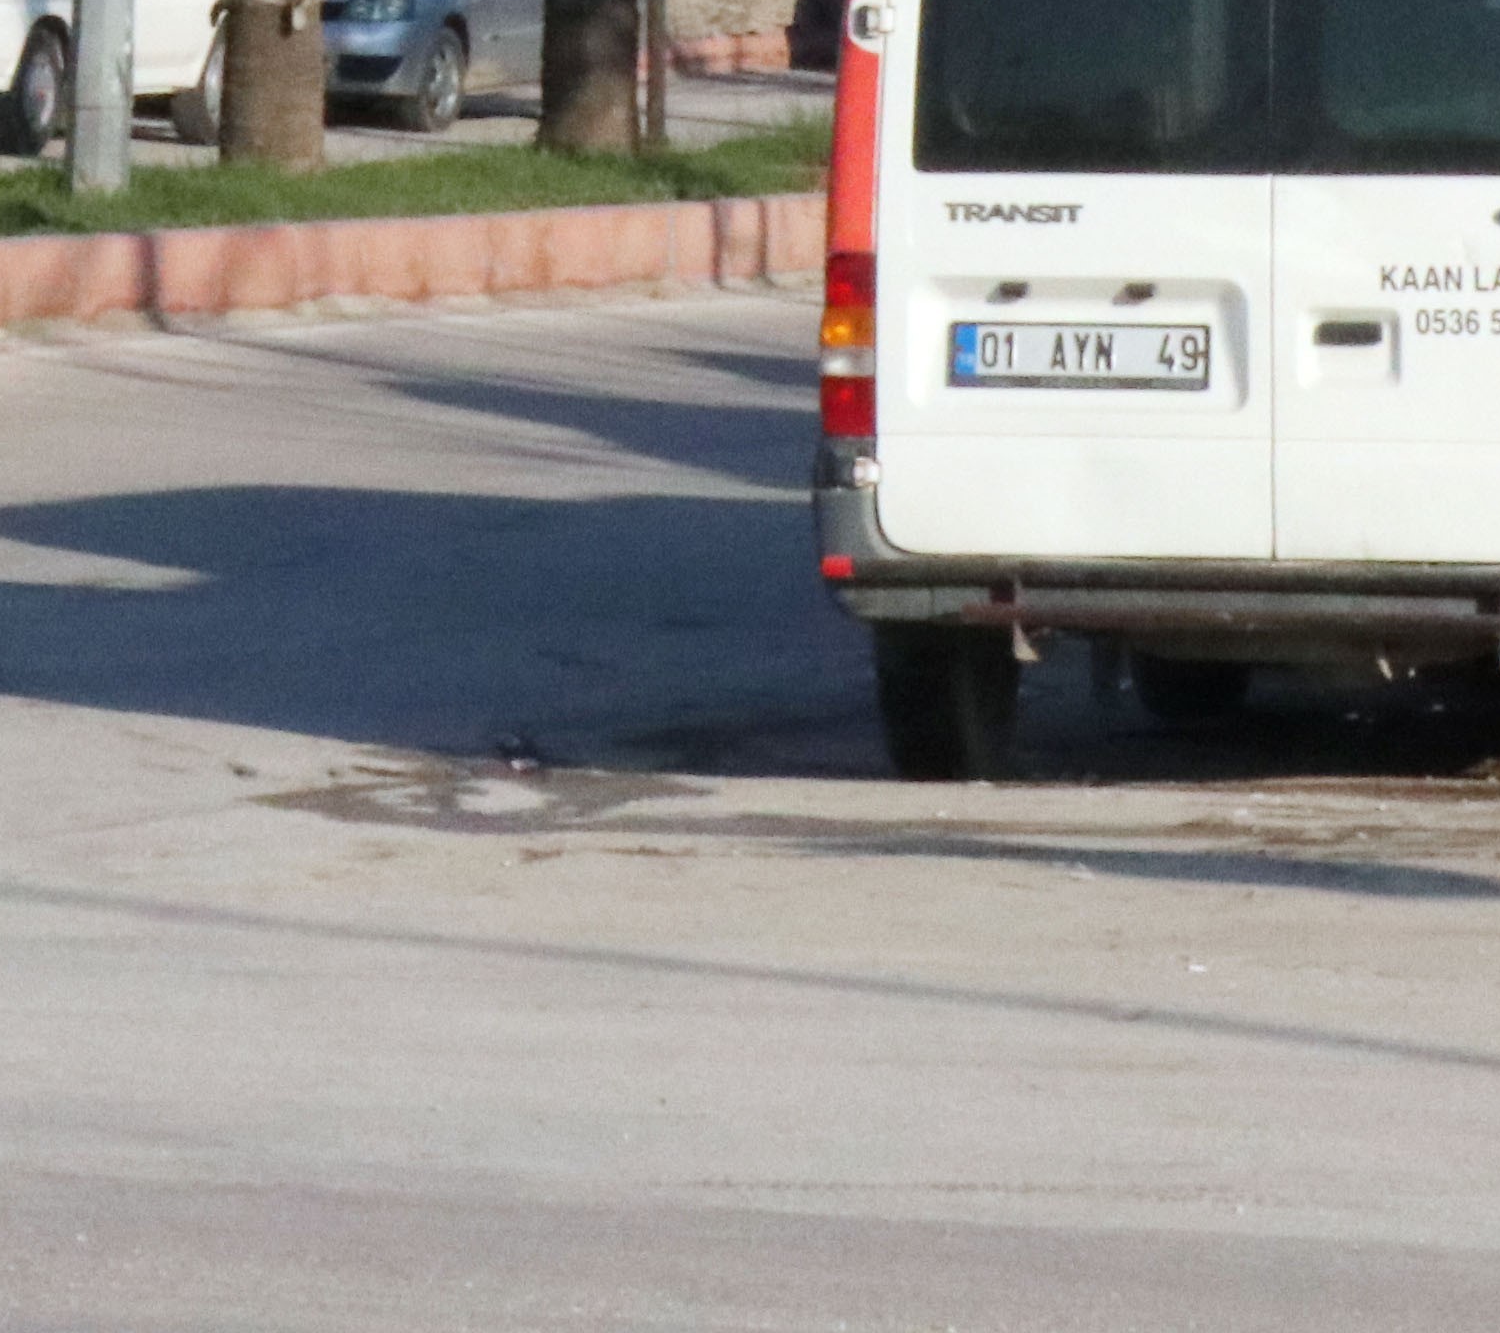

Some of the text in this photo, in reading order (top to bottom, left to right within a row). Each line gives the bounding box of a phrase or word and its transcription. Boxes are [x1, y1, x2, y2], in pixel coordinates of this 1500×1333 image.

[945, 202, 1083, 225] TRANSIT
[1379, 265, 1464, 291] KAAN
[1415, 308, 1480, 335] 0536
[980, 332, 1201, 372] 01 AYN 49
